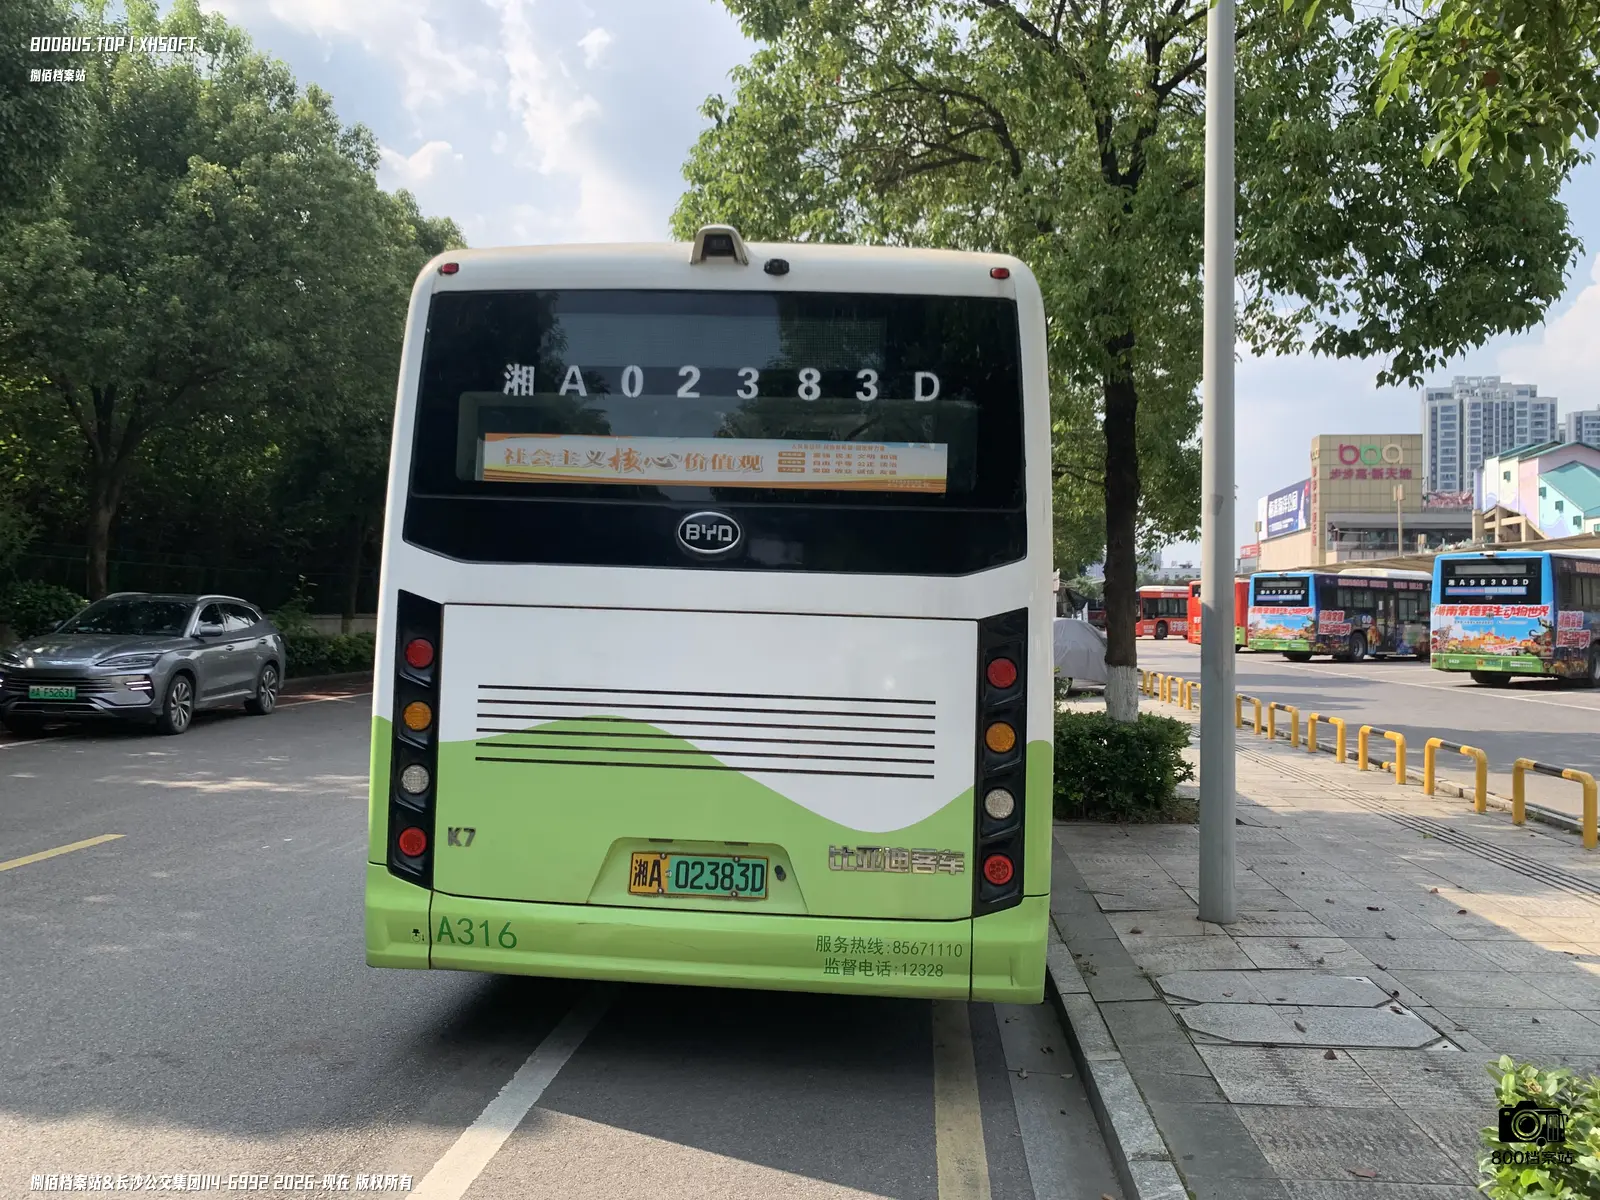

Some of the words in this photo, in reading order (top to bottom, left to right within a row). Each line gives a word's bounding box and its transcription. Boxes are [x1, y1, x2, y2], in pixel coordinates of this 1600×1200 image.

[504, 447, 764, 474] 社会主义核心价值观
[685, 523, 733, 541] BYD
[1434, 604, 1550, 618] 湖南常德野生动物世界
[447, 826, 476, 847] K7
[828, 845, 965, 875] 比亚迪客车
[437, 915, 518, 949] A316
